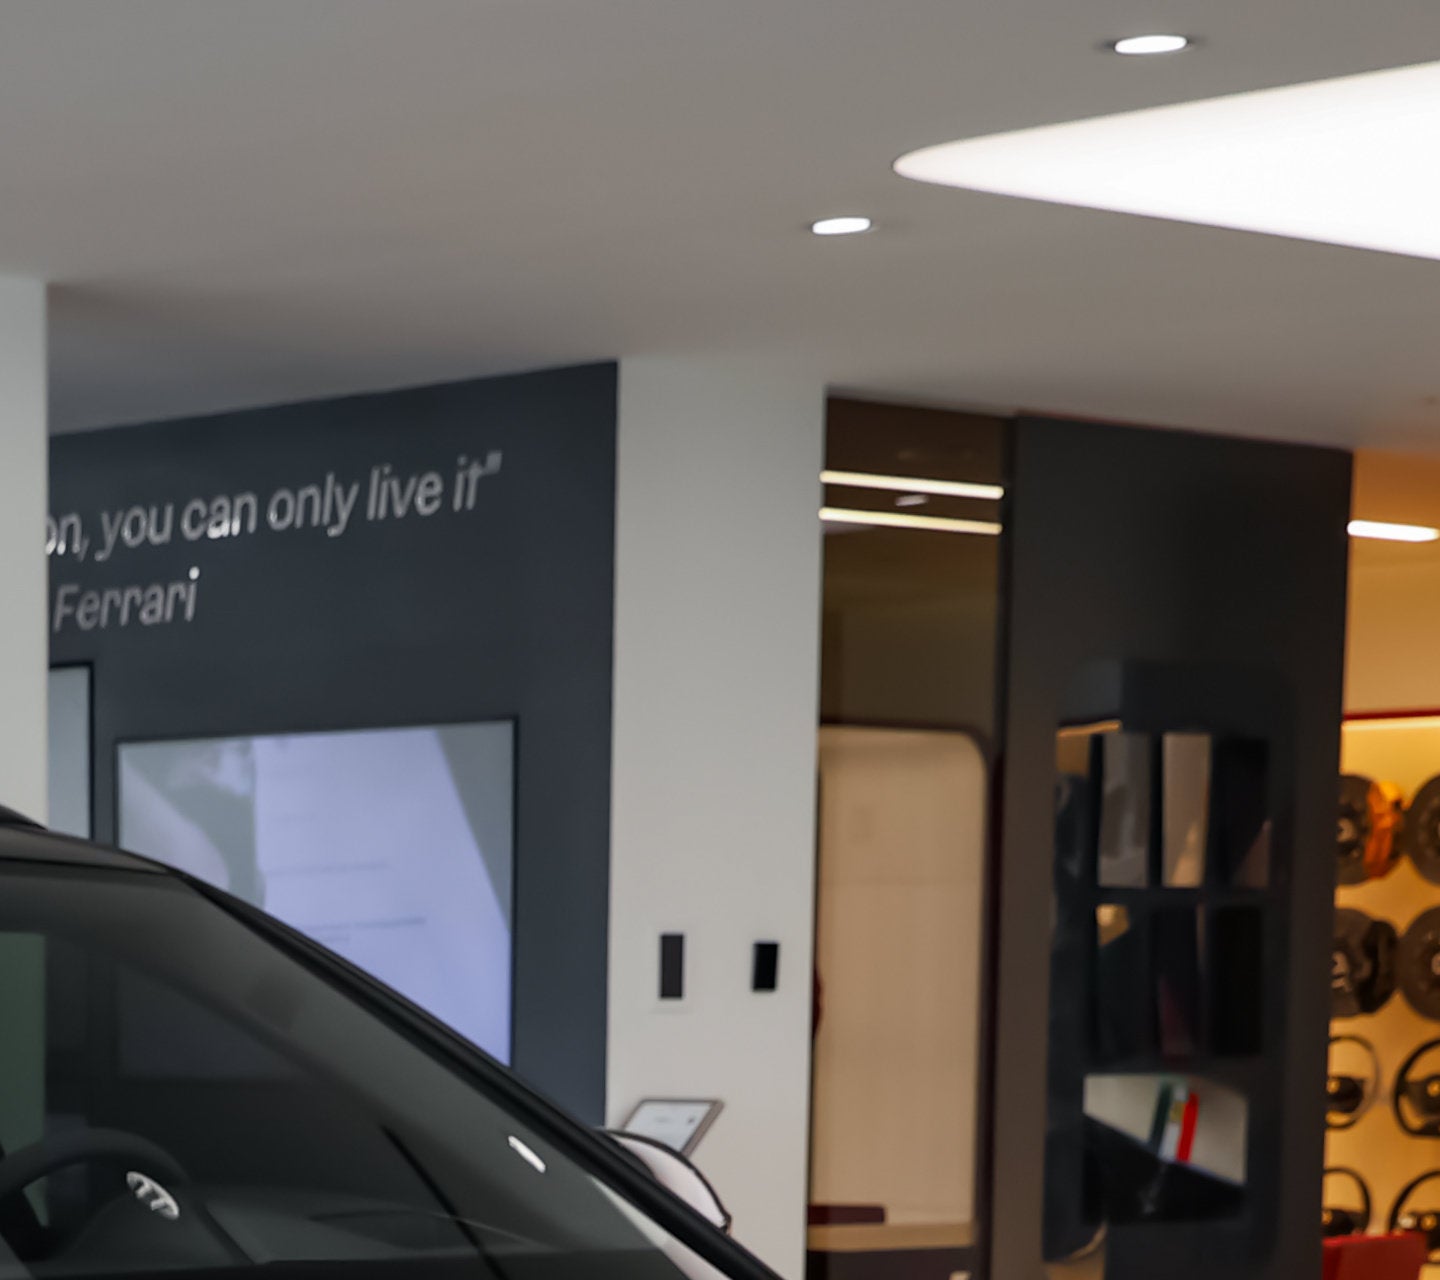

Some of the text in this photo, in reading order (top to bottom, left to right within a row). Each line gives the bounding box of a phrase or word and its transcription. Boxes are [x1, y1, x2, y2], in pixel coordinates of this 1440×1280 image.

[94, 503, 175, 562] you
[180, 491, 259, 540] can
[267, 471, 360, 538] only
[366, 463, 444, 522] live
[53, 565, 201, 632] Ferrari
